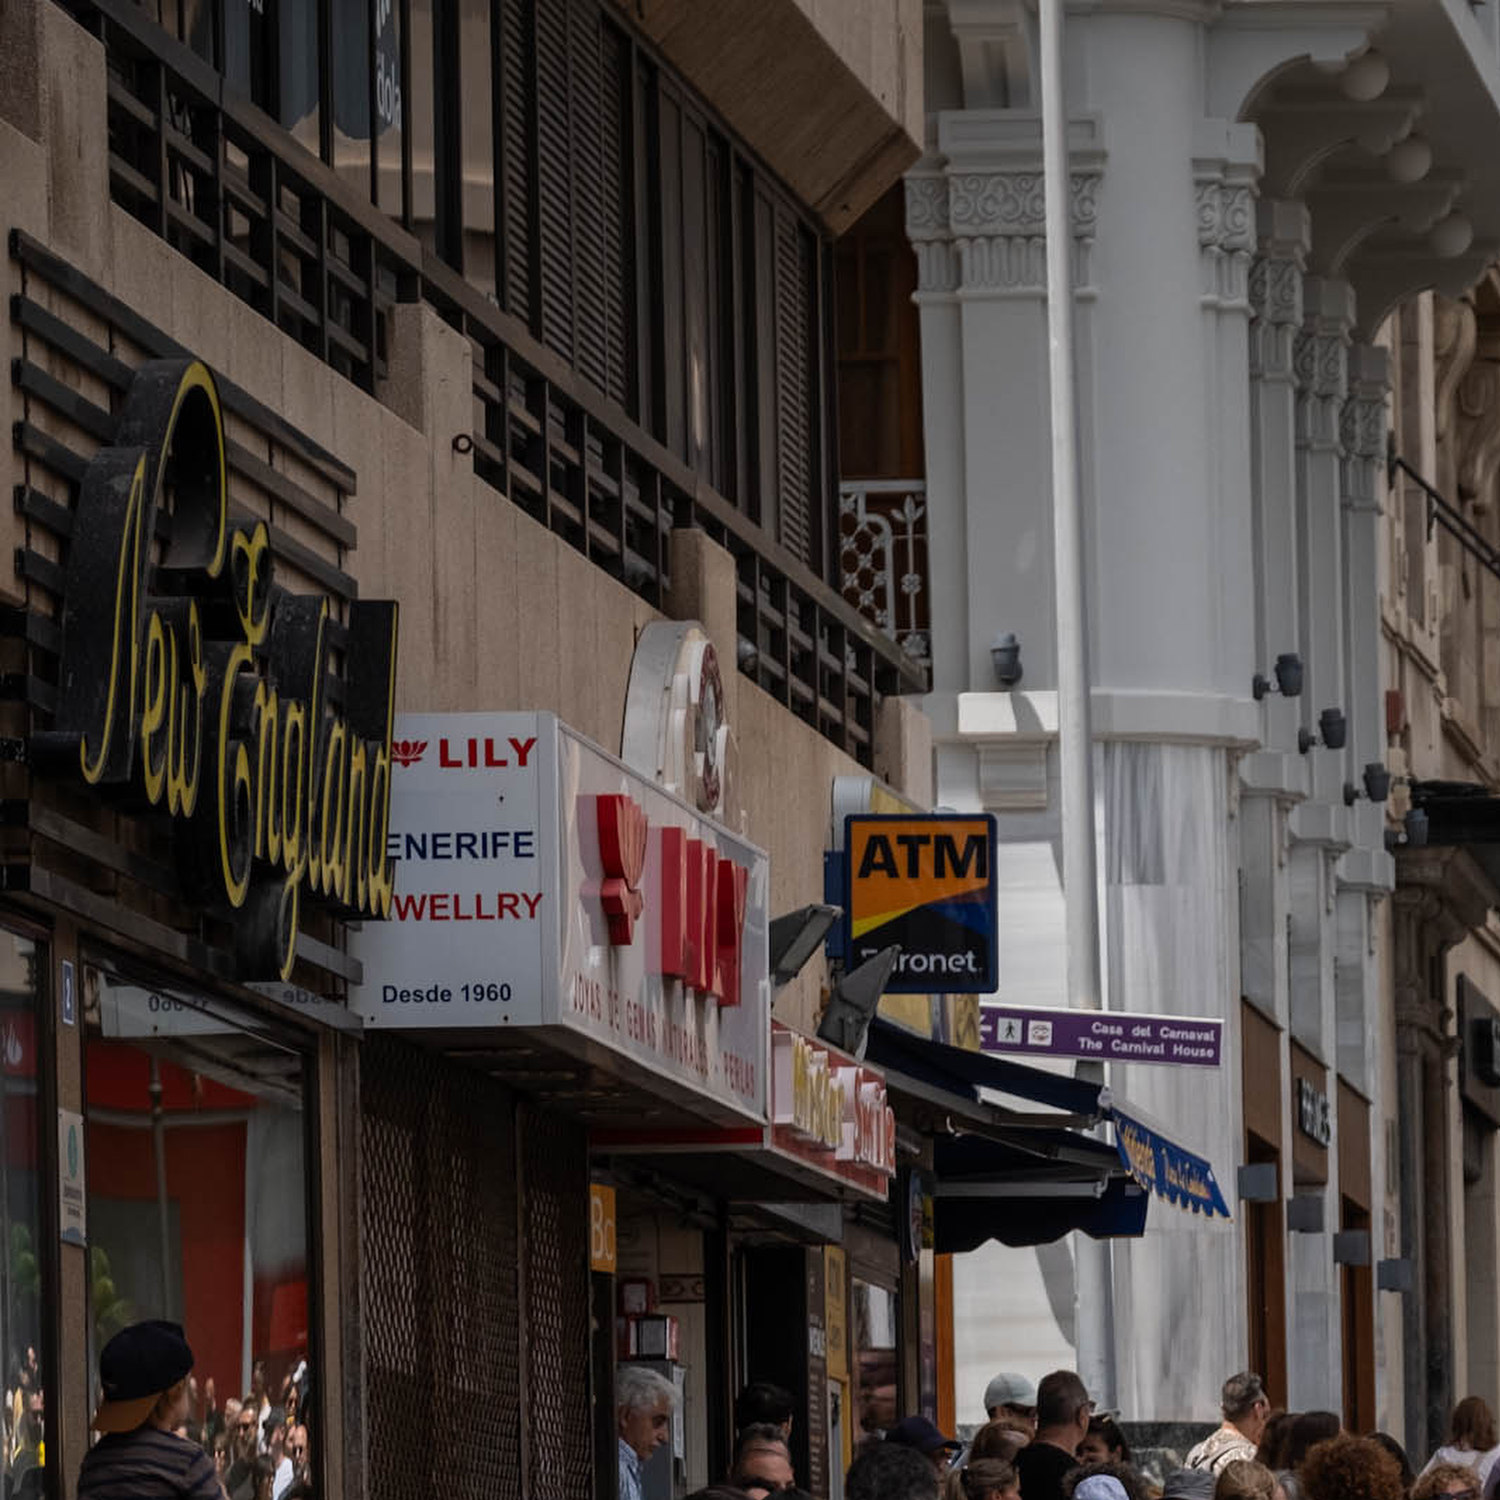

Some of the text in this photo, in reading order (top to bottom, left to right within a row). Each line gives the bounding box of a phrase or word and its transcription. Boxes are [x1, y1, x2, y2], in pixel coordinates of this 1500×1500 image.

[80, 361, 228, 818] New
[217, 518, 399, 983] England
[438, 737, 537, 768] LILY
[386, 831, 535, 860] ENERIFE
[857, 834, 987, 879] ATM
[393, 892, 543, 921] WELLRY
[861, 948, 977, 974] ronet
[382, 983, 512, 1003] Desde 1960
[1092, 1021, 1216, 1042] Casa del Carnaval
[1078, 1037, 1215, 1058] The Carnival House
